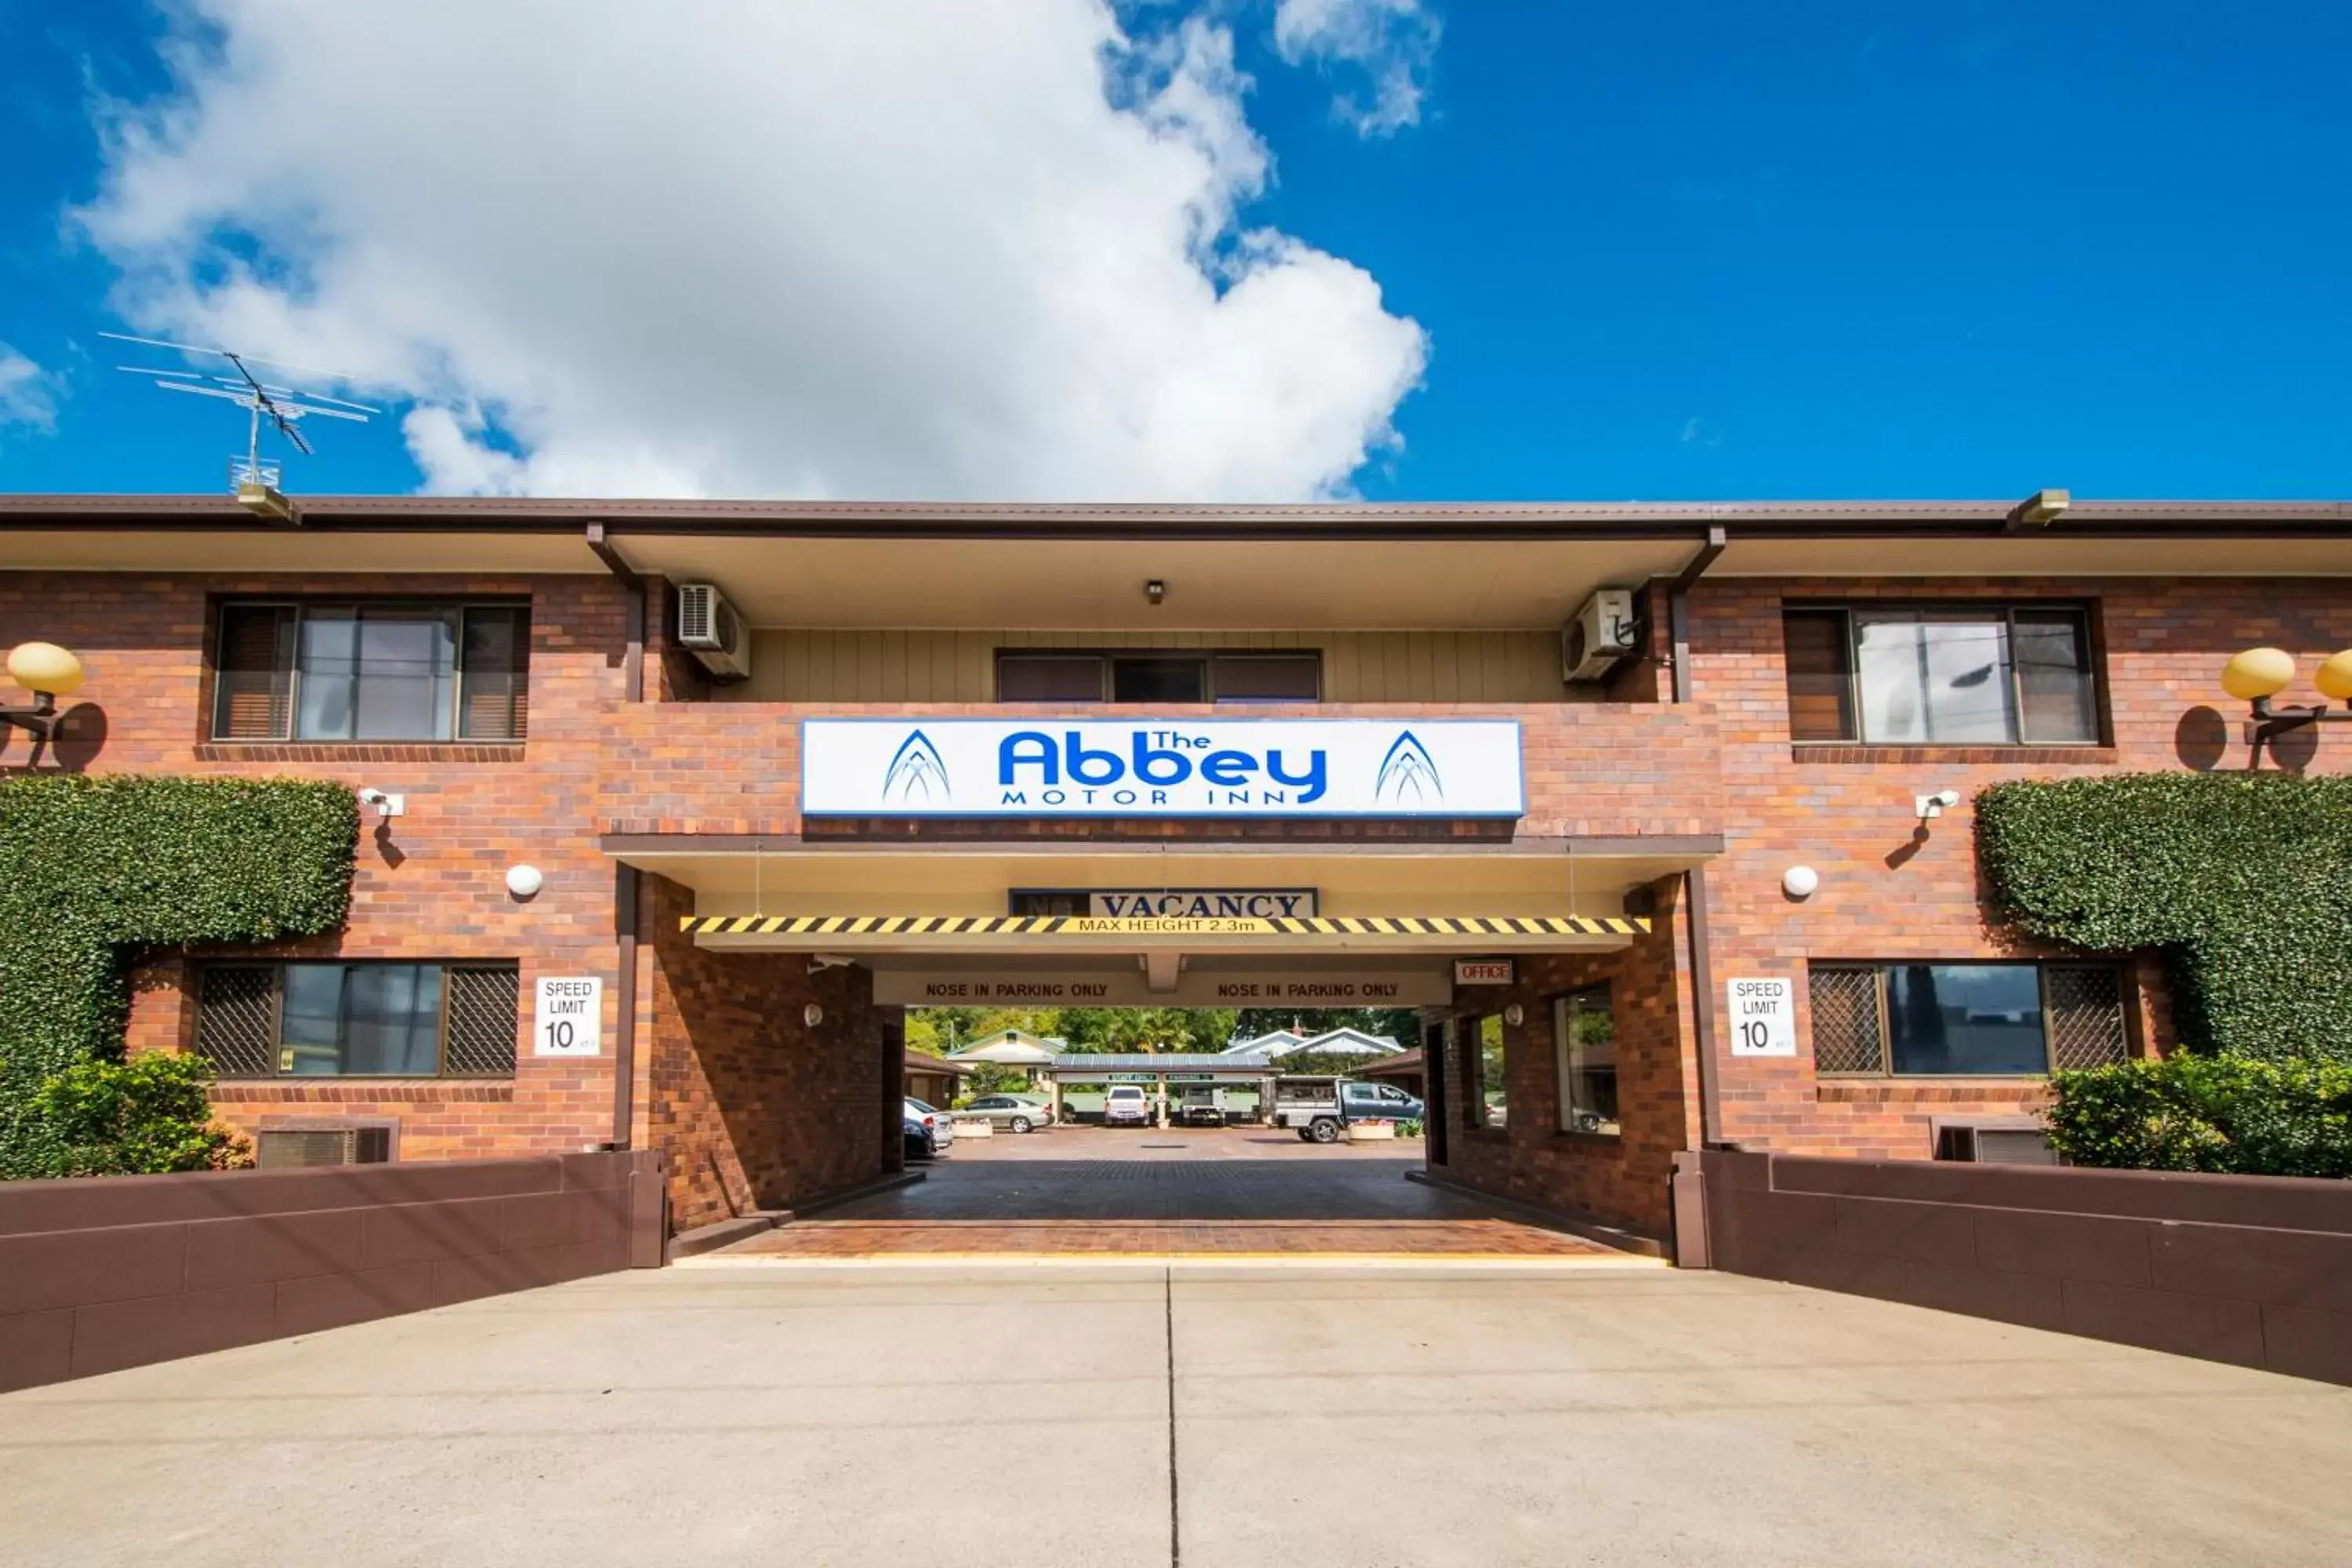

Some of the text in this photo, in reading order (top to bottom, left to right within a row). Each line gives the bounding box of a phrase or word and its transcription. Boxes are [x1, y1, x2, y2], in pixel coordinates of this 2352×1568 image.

[1152, 731, 1211, 749] The
[999, 731, 1327, 804] Abbey
[1002, 789, 1284, 805] MOTOR INN
[1101, 895, 1301, 917] VACANCY
[1079, 920, 1255, 931] MAX HEIGHT 2.3m
[1462, 965, 1509, 979] OFFICE
[546, 982, 592, 996] SPEED
[927, 984, 1107, 996] NOSE IN PARKING ONLY
[1218, 984, 1399, 996] NOSE IN PARKING ONLY
[1737, 982, 1784, 996] SPEED
[550, 1000, 586, 1013] LIMIT
[1743, 1001, 1778, 1014] LIMIT
[545, 1021, 573, 1048] 10
[1739, 1021, 1768, 1047] 10
